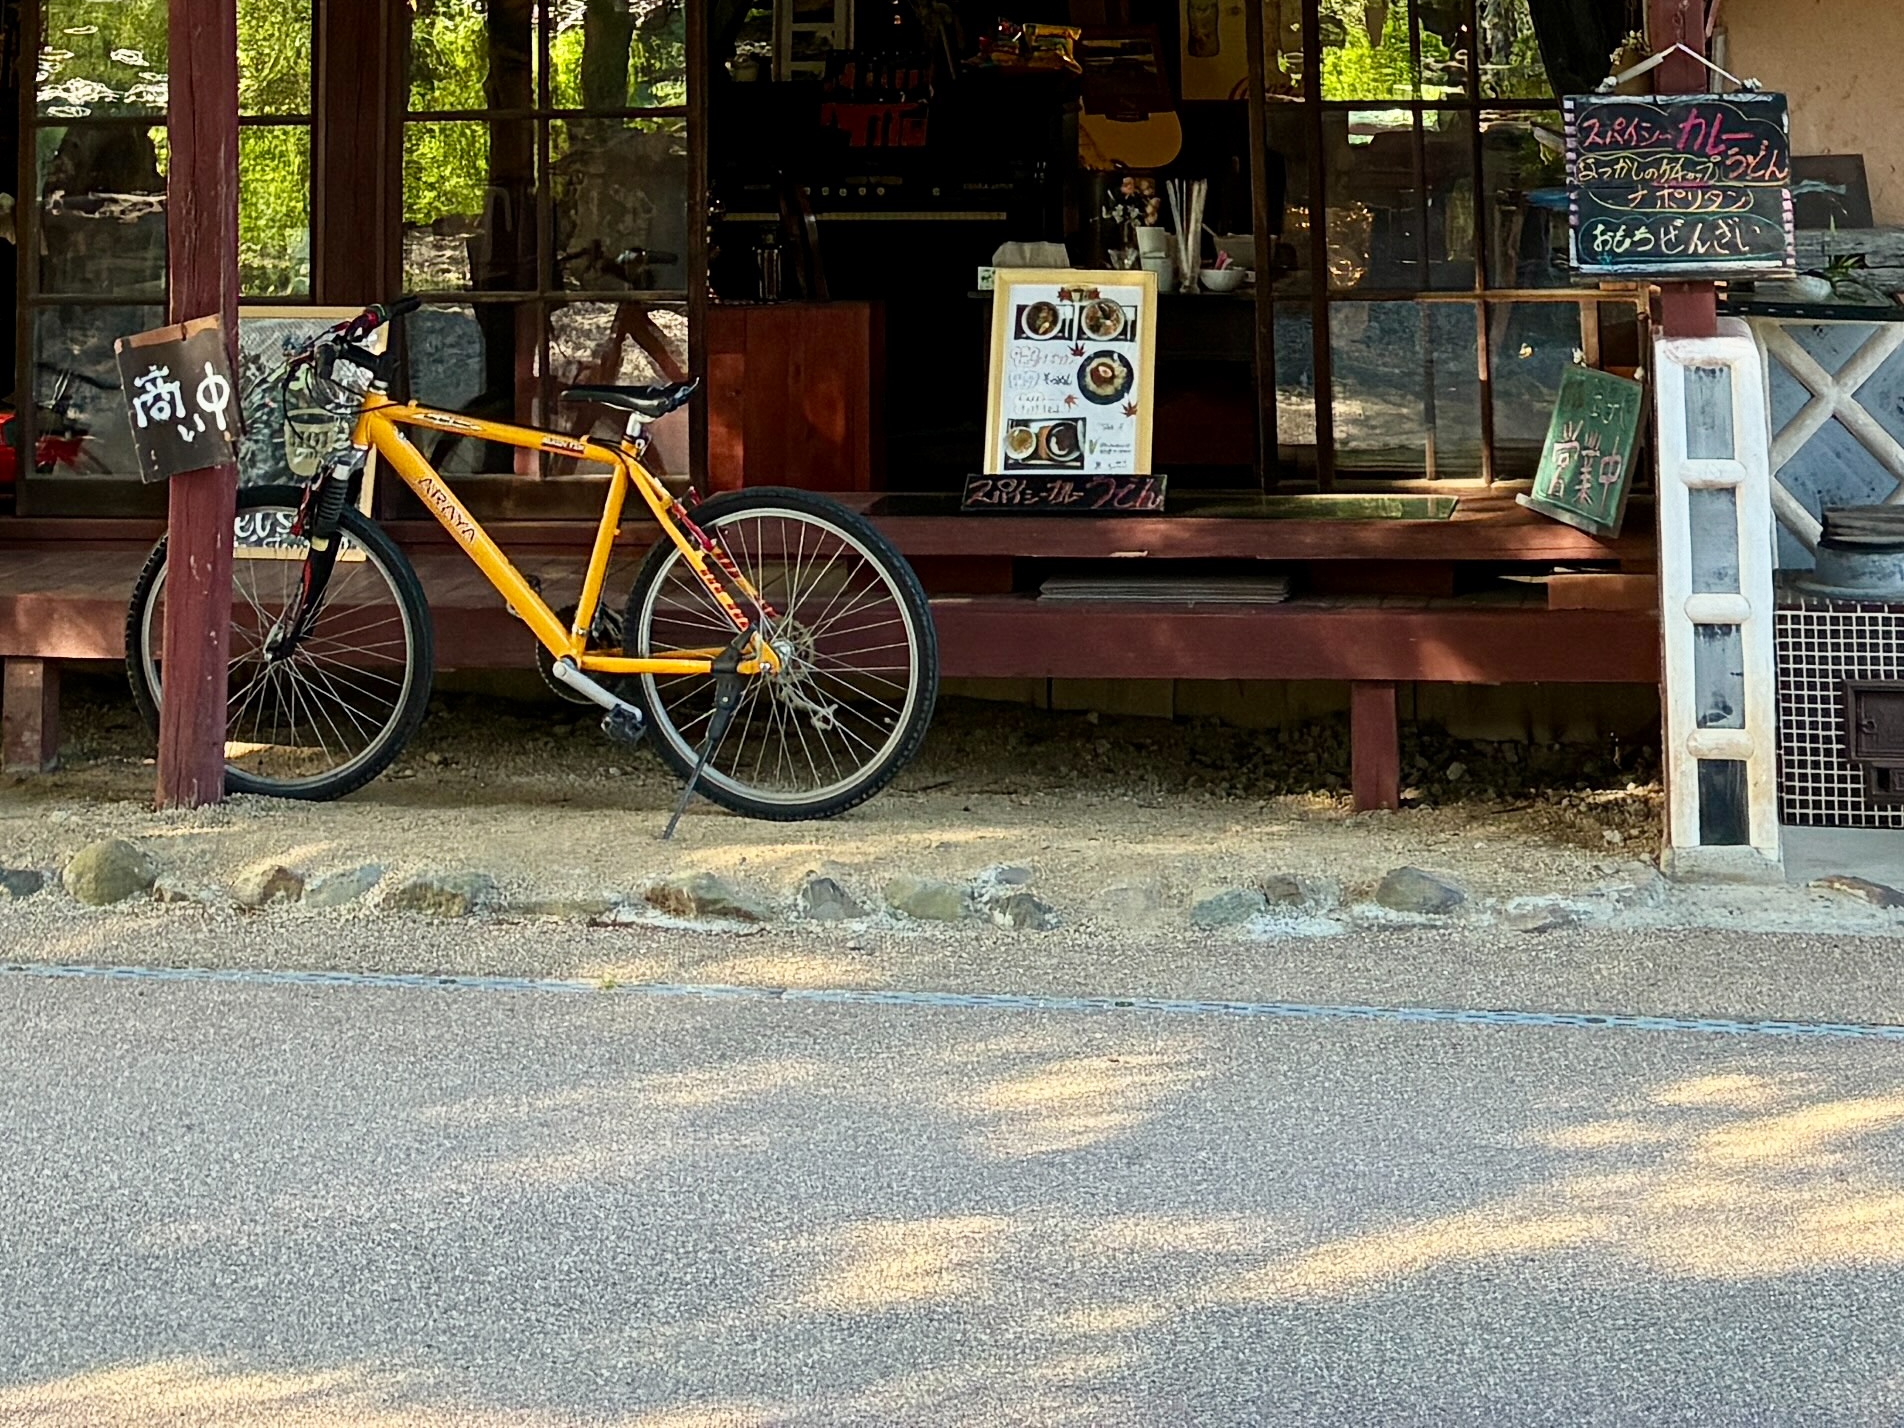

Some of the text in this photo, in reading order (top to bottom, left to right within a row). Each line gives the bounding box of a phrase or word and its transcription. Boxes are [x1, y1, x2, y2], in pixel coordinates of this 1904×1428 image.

[1727, 139, 1789, 180] うどん
[1627, 183, 1747, 210] ナポリタン
[1592, 217, 1761, 255] おもちぜんざい
[132, 361, 231, 443] 商い中
[1547, 420, 1623, 508] 営業中
[417, 477, 476, 543] ARAYA
